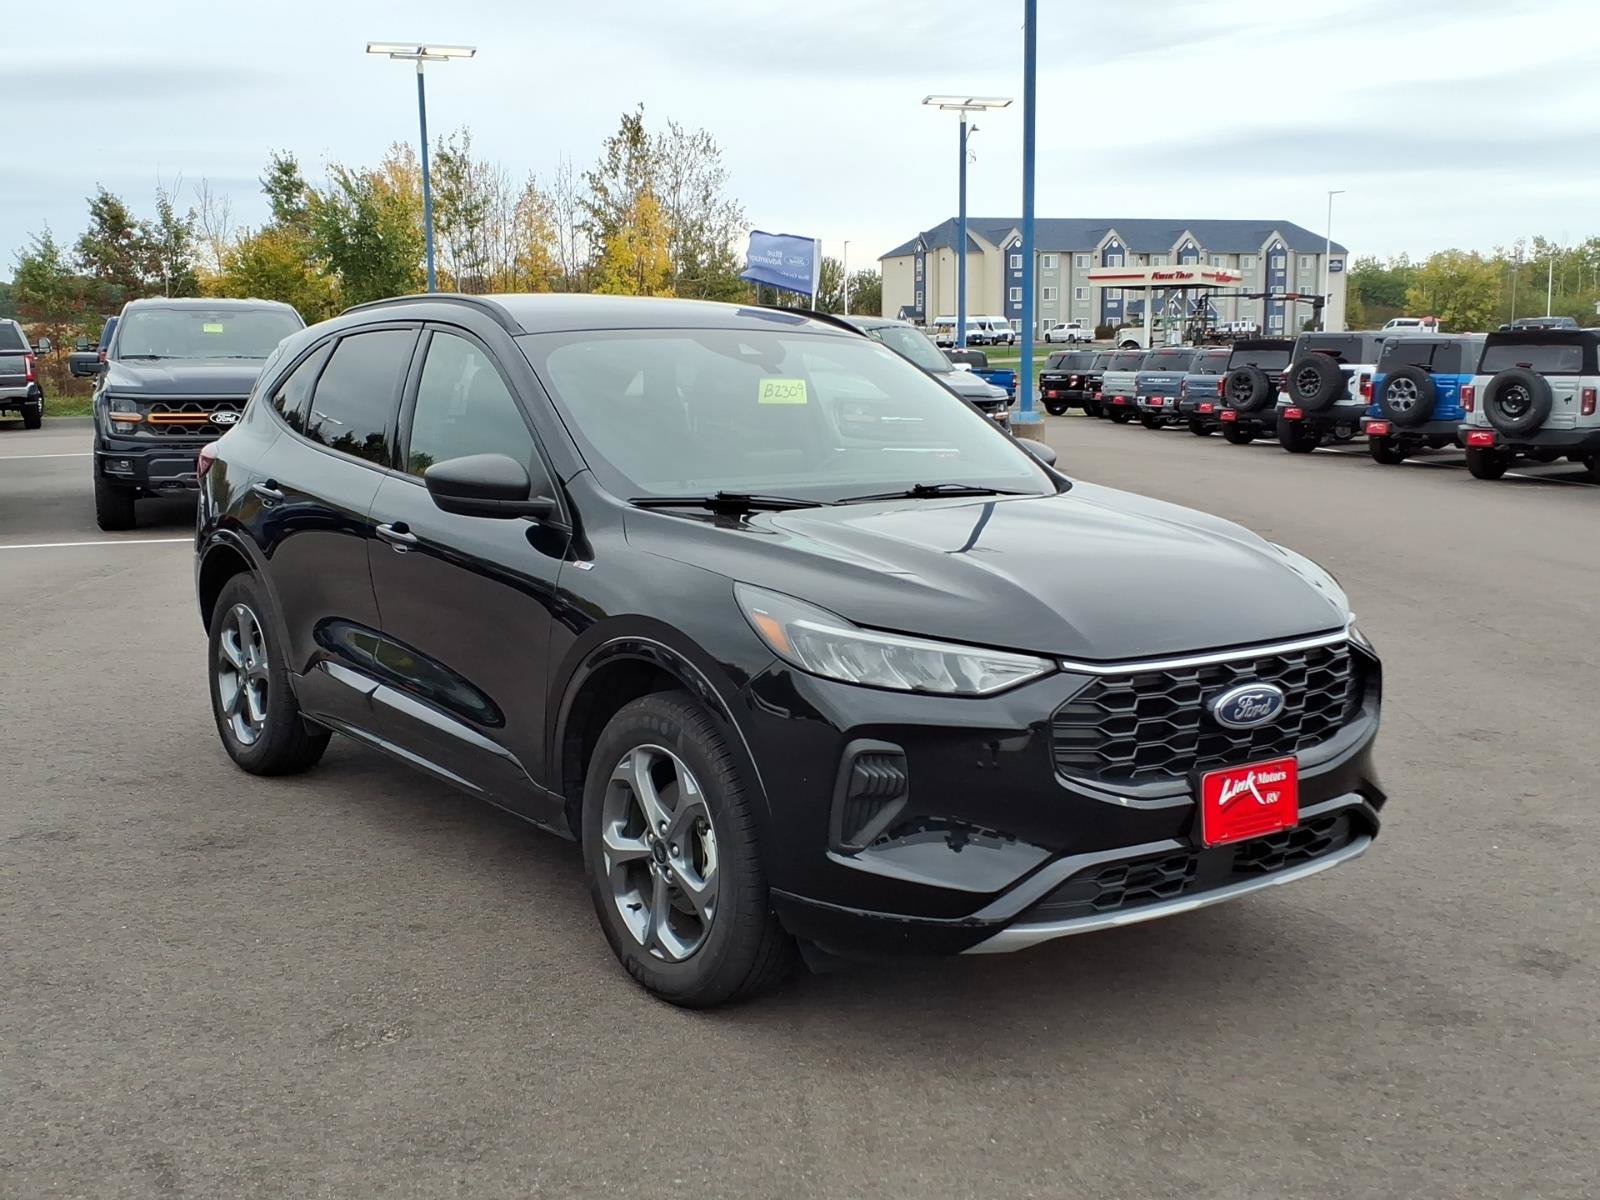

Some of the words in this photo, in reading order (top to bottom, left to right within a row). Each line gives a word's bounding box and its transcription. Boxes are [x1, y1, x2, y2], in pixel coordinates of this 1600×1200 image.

[1175, 271, 1194, 280] TRIP
[1233, 694, 1272, 720] Ford
[1218, 771, 1266, 805] Link
[1257, 772, 1287, 785] Motors
[1266, 792, 1280, 804] RV
